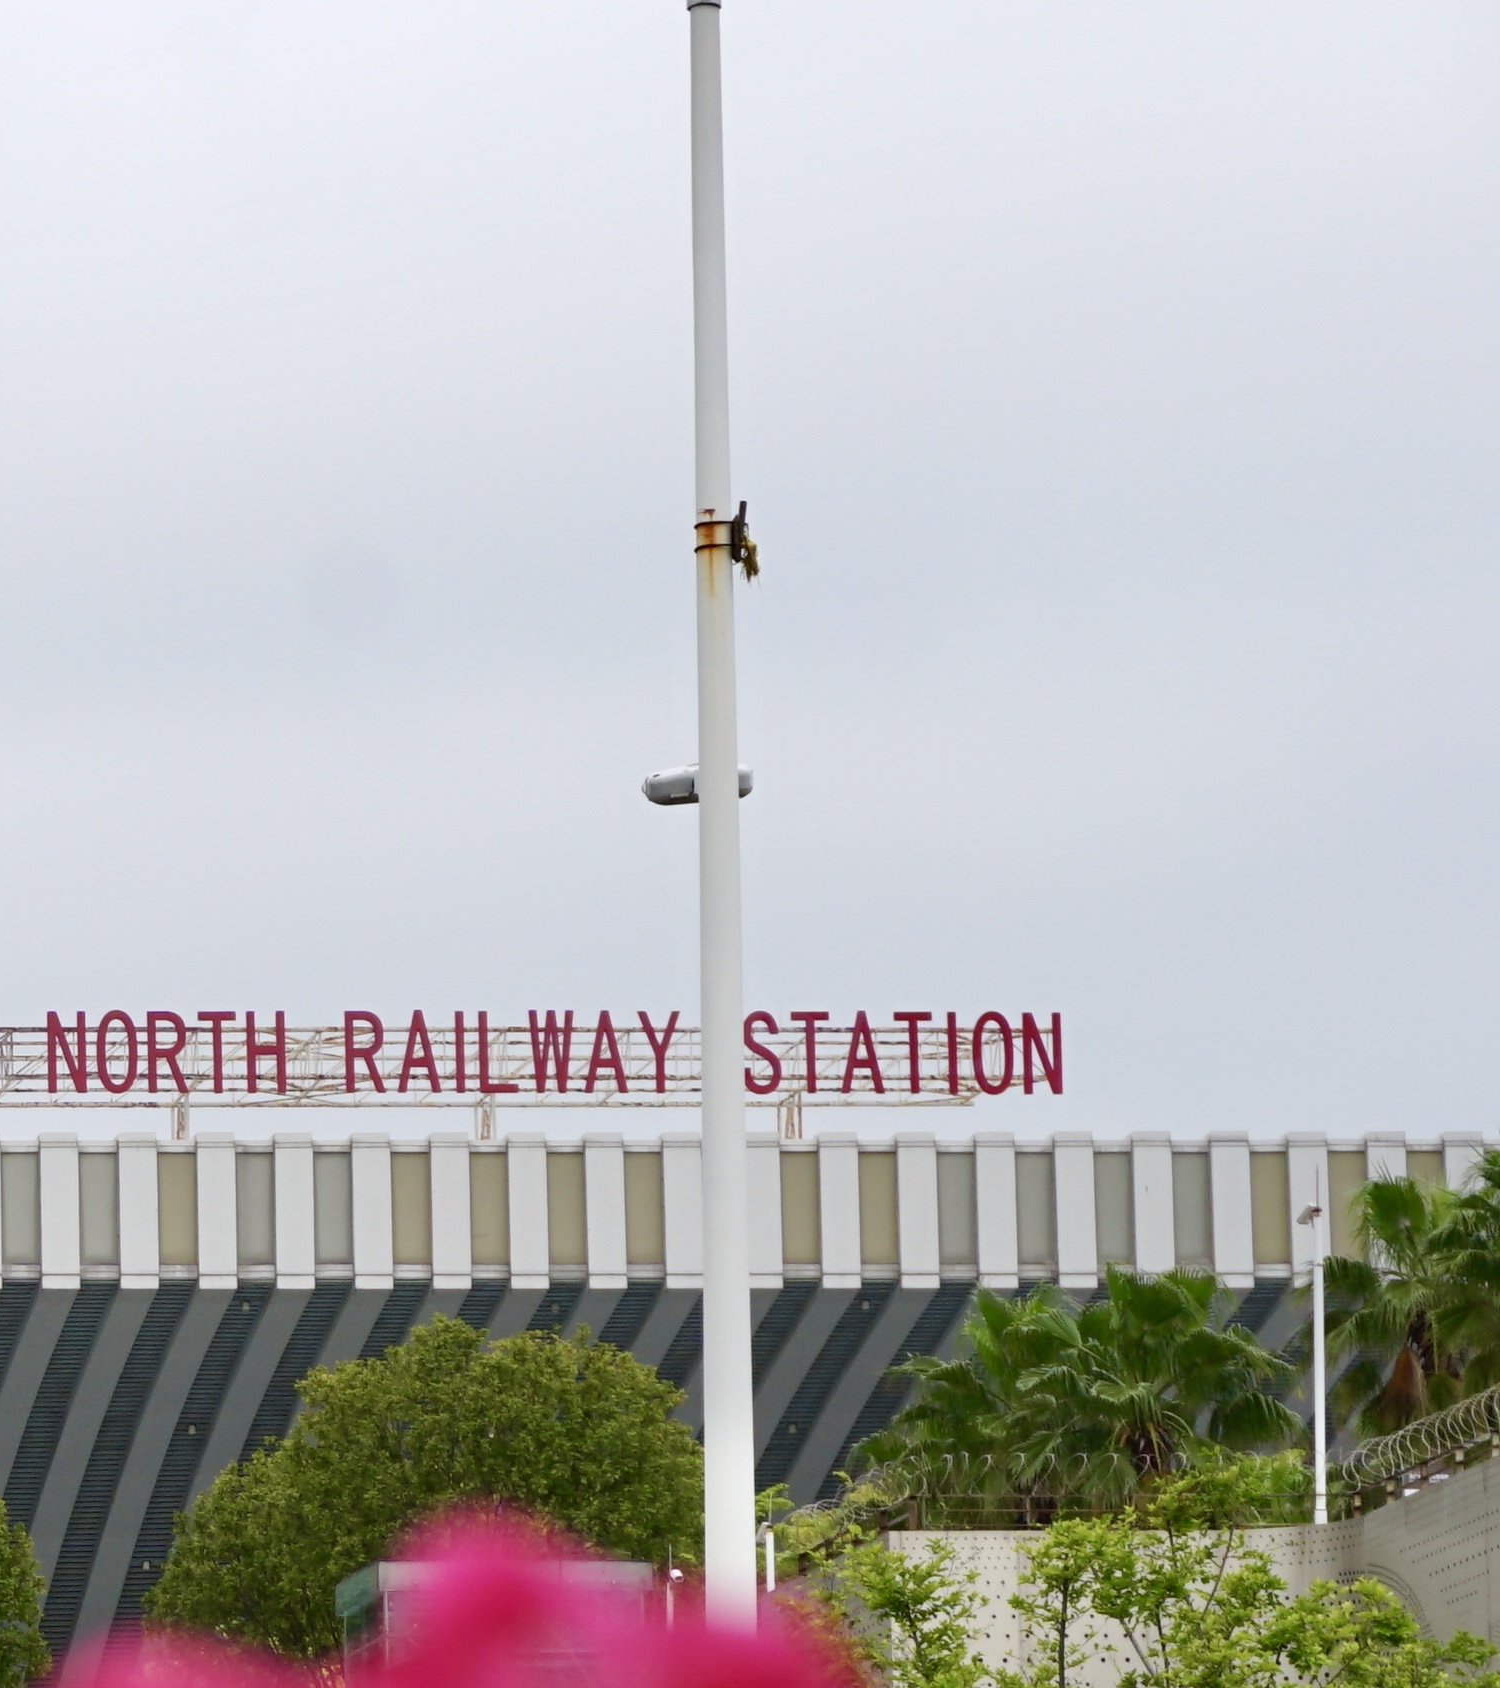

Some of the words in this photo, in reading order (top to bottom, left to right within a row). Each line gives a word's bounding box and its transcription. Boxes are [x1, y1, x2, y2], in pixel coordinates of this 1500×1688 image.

[47, 1011, 287, 1094] NORTH
[343, 1011, 682, 1094] RAILWAY
[743, 1011, 1063, 1095] STATION
